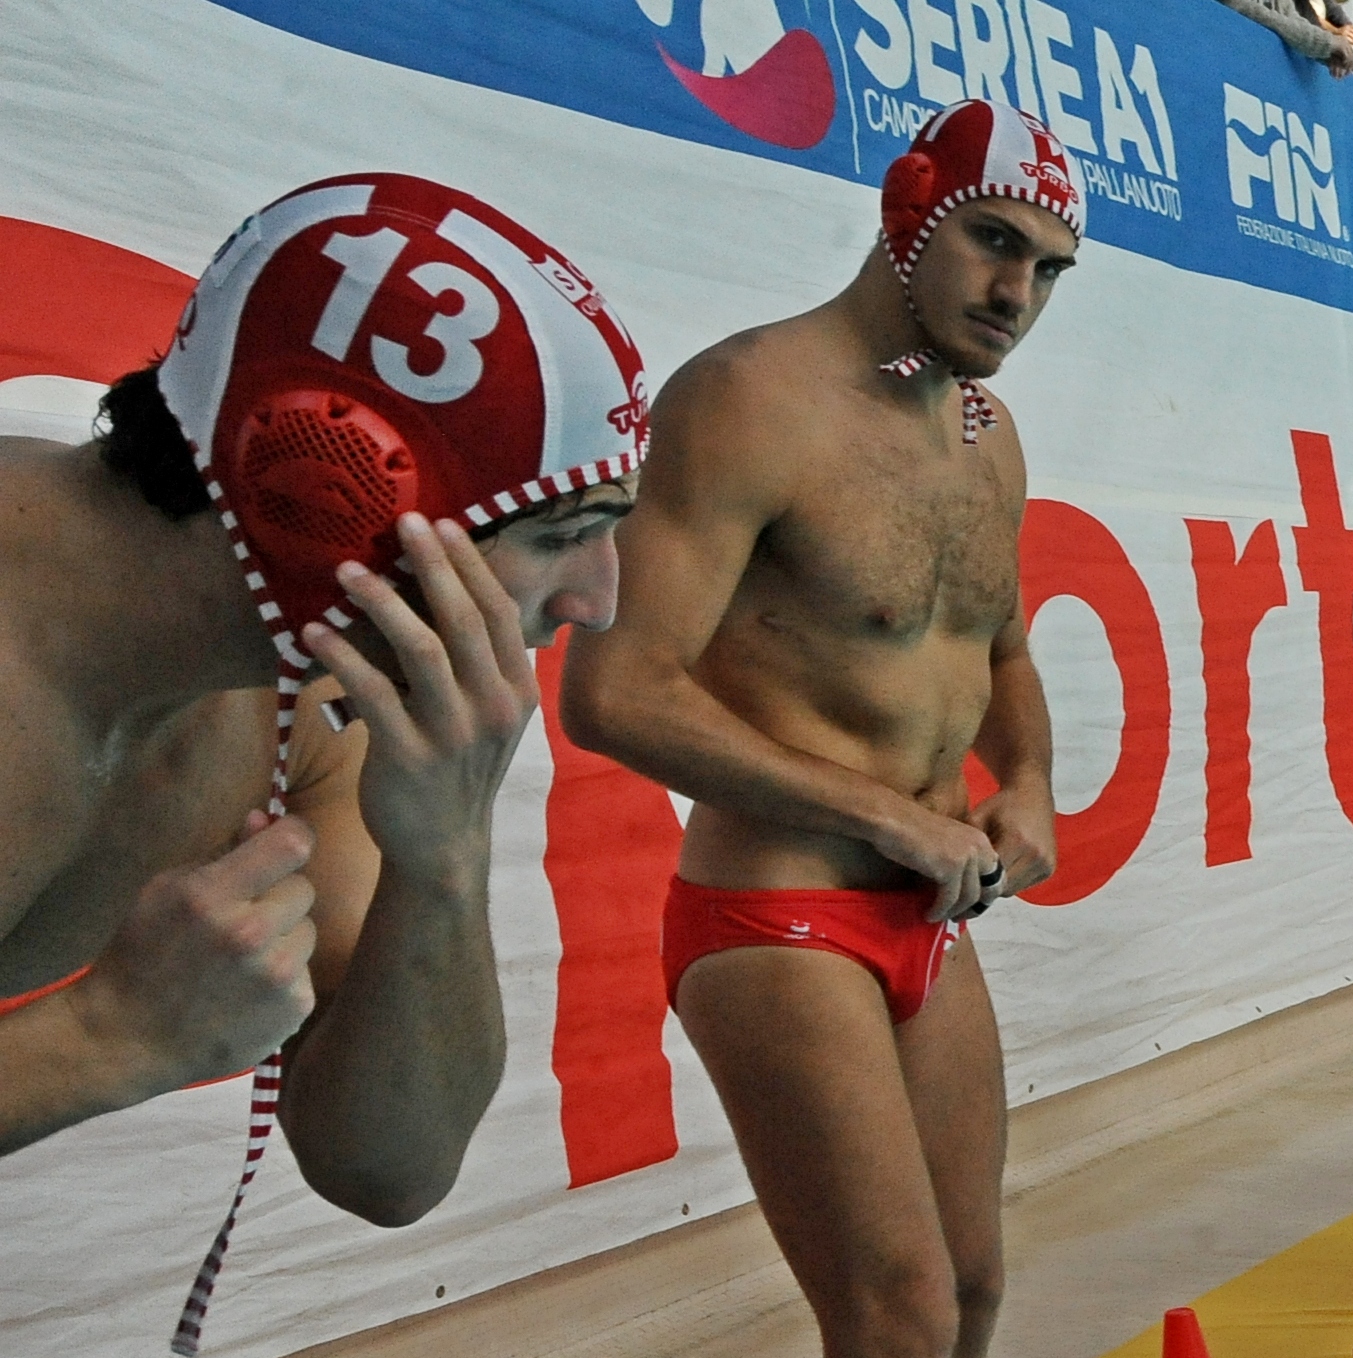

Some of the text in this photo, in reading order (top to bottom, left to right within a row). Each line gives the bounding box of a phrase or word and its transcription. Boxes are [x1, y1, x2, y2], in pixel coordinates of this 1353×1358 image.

[854, 0, 1178, 181] SERIE A1
[1223, 82, 1341, 239] FIN
[1020, 163, 1078, 204] TURBO
[1085, 162, 1182, 221] PALLANUOTO
[310, 226, 500, 404] 13
